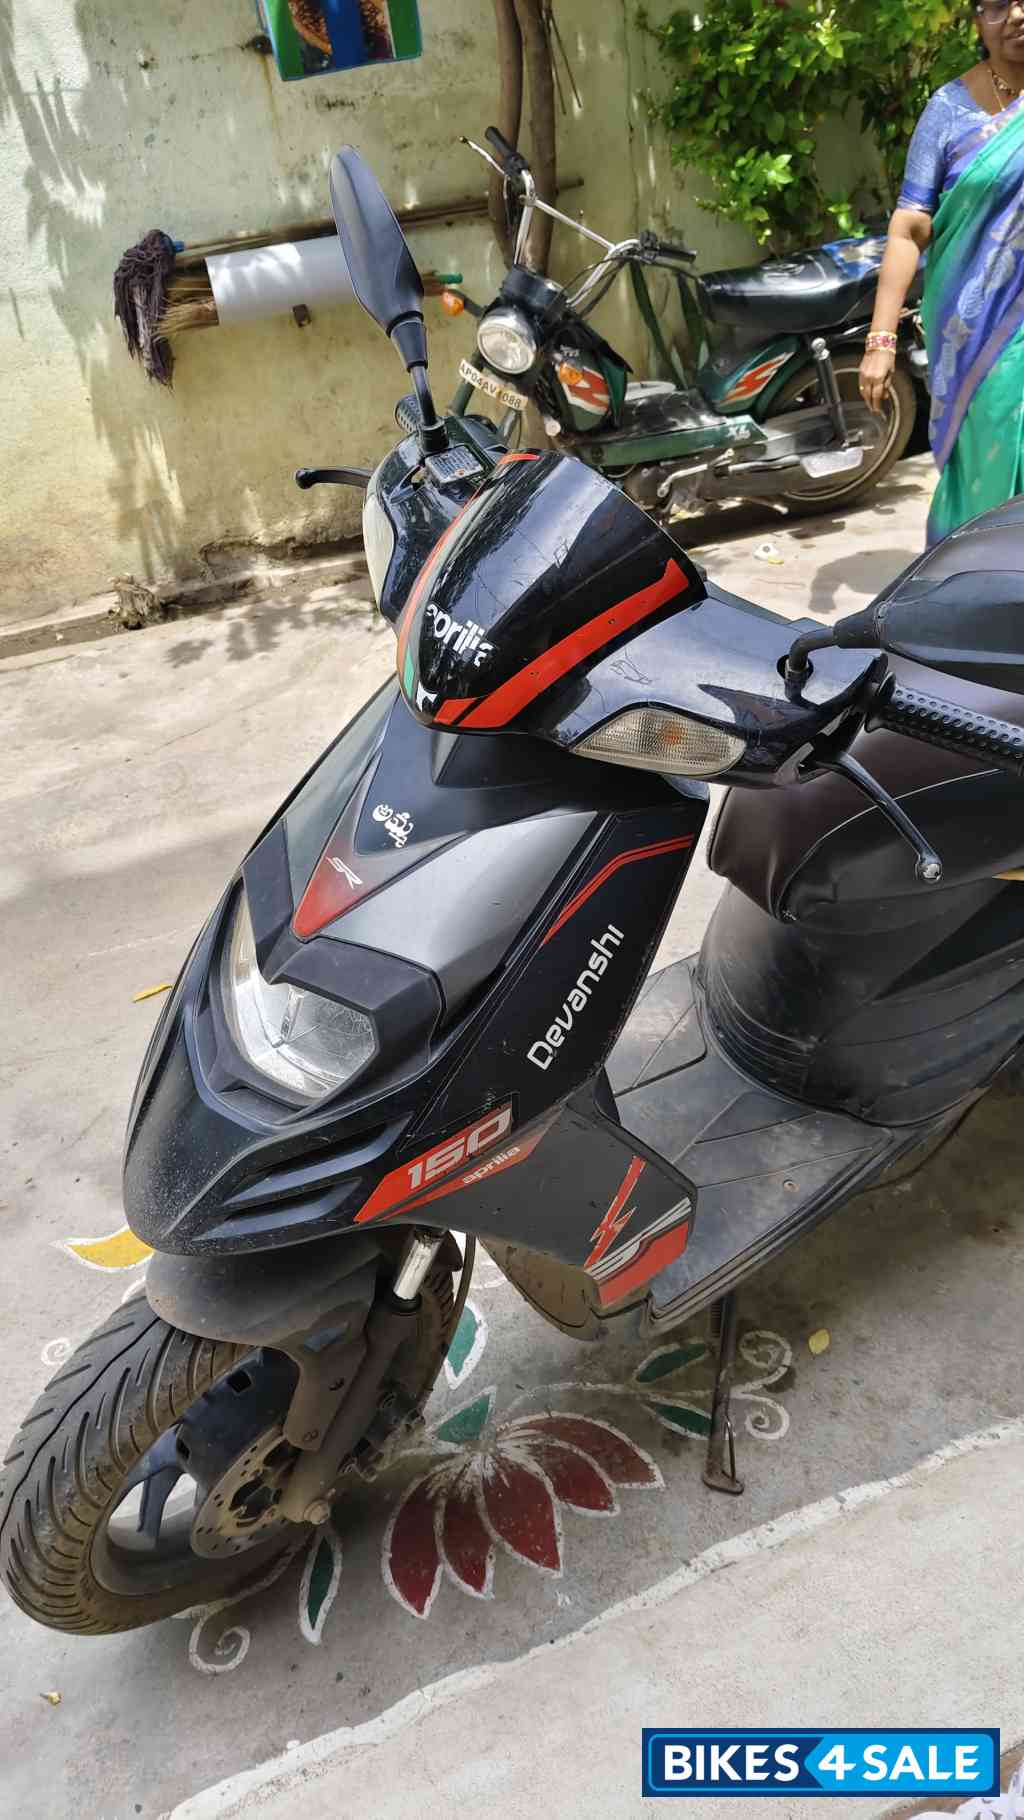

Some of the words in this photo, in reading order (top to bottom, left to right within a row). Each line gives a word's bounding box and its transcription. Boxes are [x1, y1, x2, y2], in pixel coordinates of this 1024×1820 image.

[460, 363, 522, 408] AP04AV088
[527, 924, 625, 1070] Devanshi
[408, 1108, 511, 1190] 150
[463, 1147, 521, 1184] aprilia
